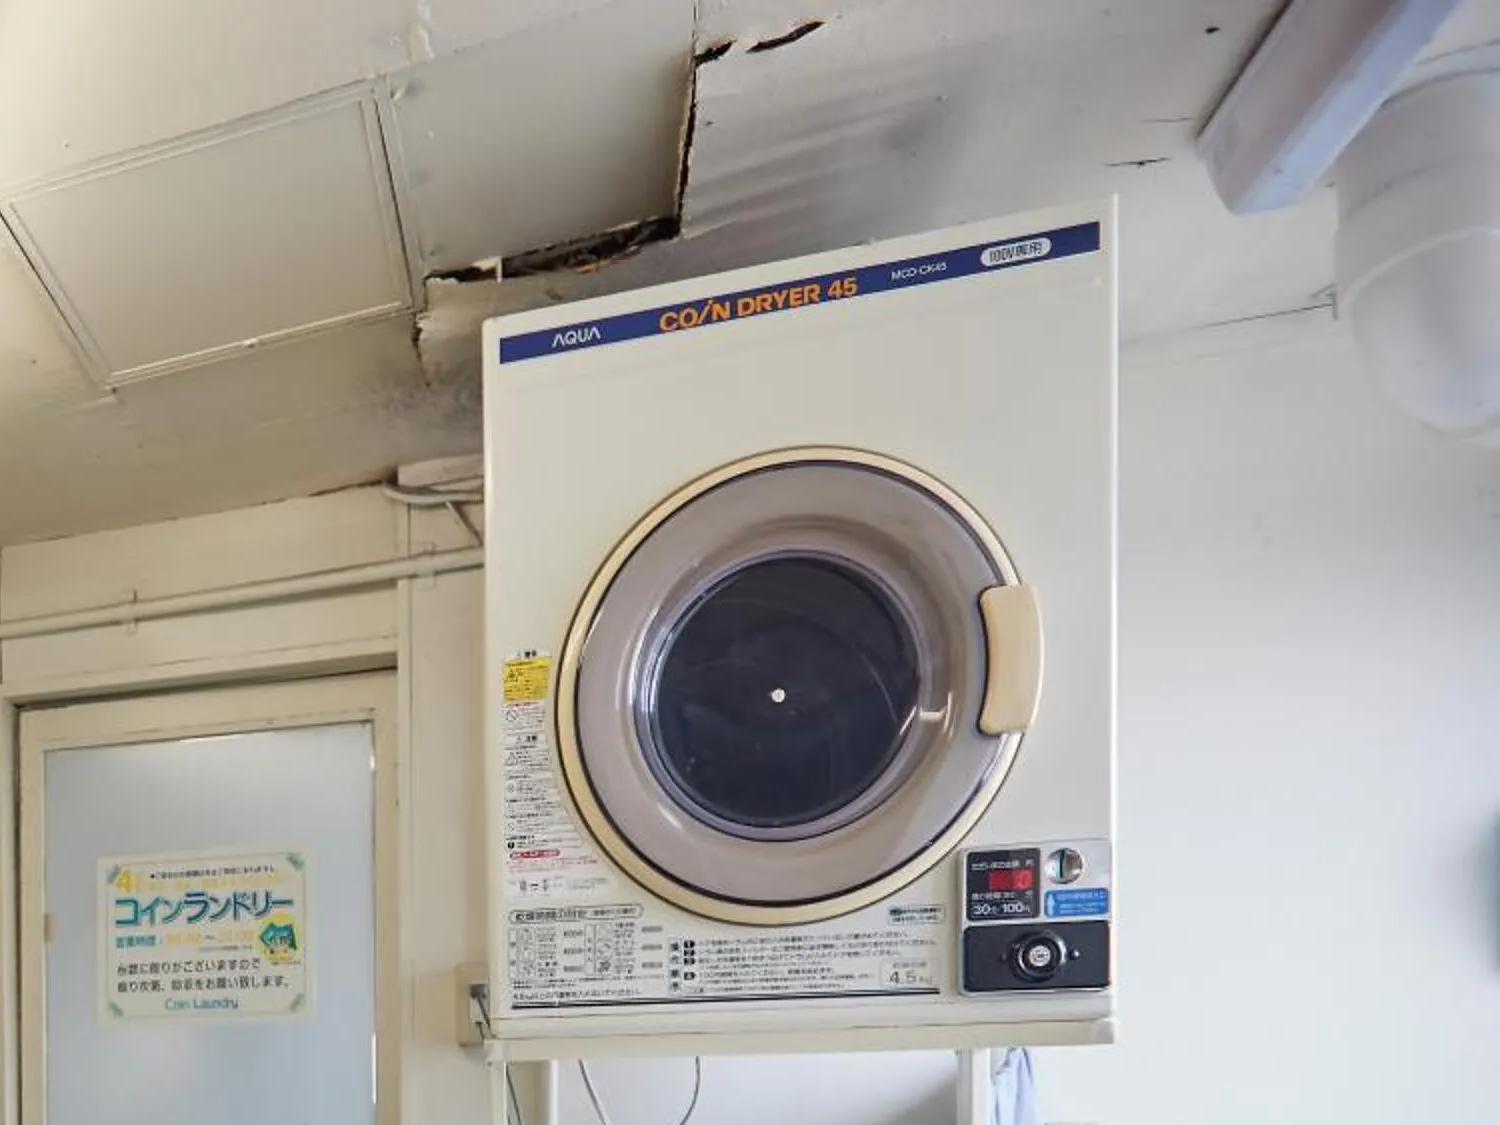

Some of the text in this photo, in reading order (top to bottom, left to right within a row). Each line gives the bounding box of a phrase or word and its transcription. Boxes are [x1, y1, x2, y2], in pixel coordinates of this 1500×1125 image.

[737, 284, 821, 319] DRYER
[827, 276, 858, 299] 45
[552, 325, 601, 347] AQUA
[115, 891, 295, 926] コインランドリー
